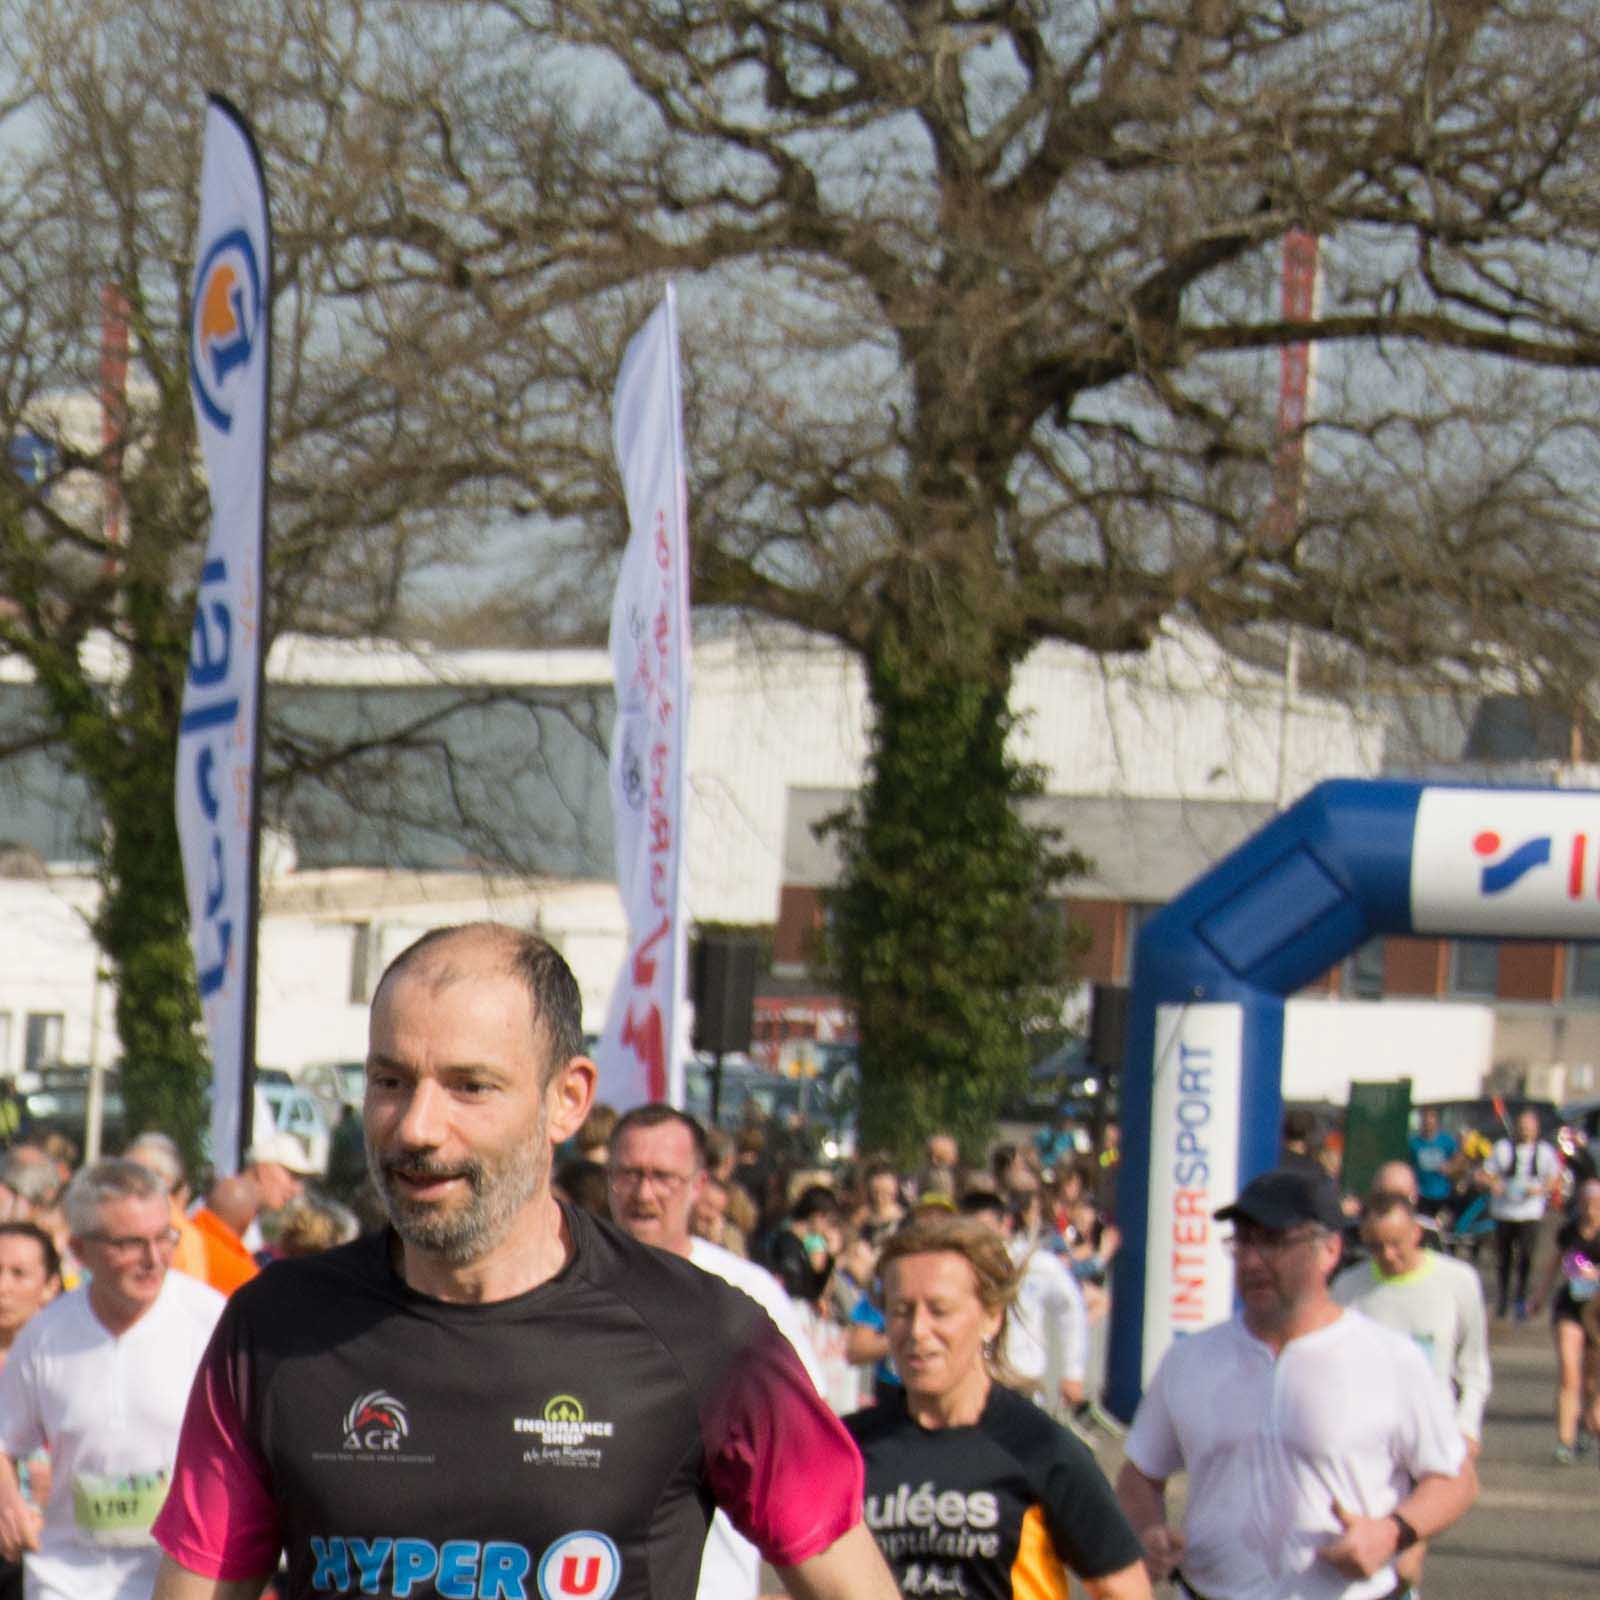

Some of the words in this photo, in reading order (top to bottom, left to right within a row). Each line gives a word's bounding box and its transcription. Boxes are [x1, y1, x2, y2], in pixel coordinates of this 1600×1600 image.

[1170, 1040, 1213, 1324] INTERSPORT
[513, 1417, 615, 1437] ENDURANCE
[343, 1429, 401, 1451] ACR
